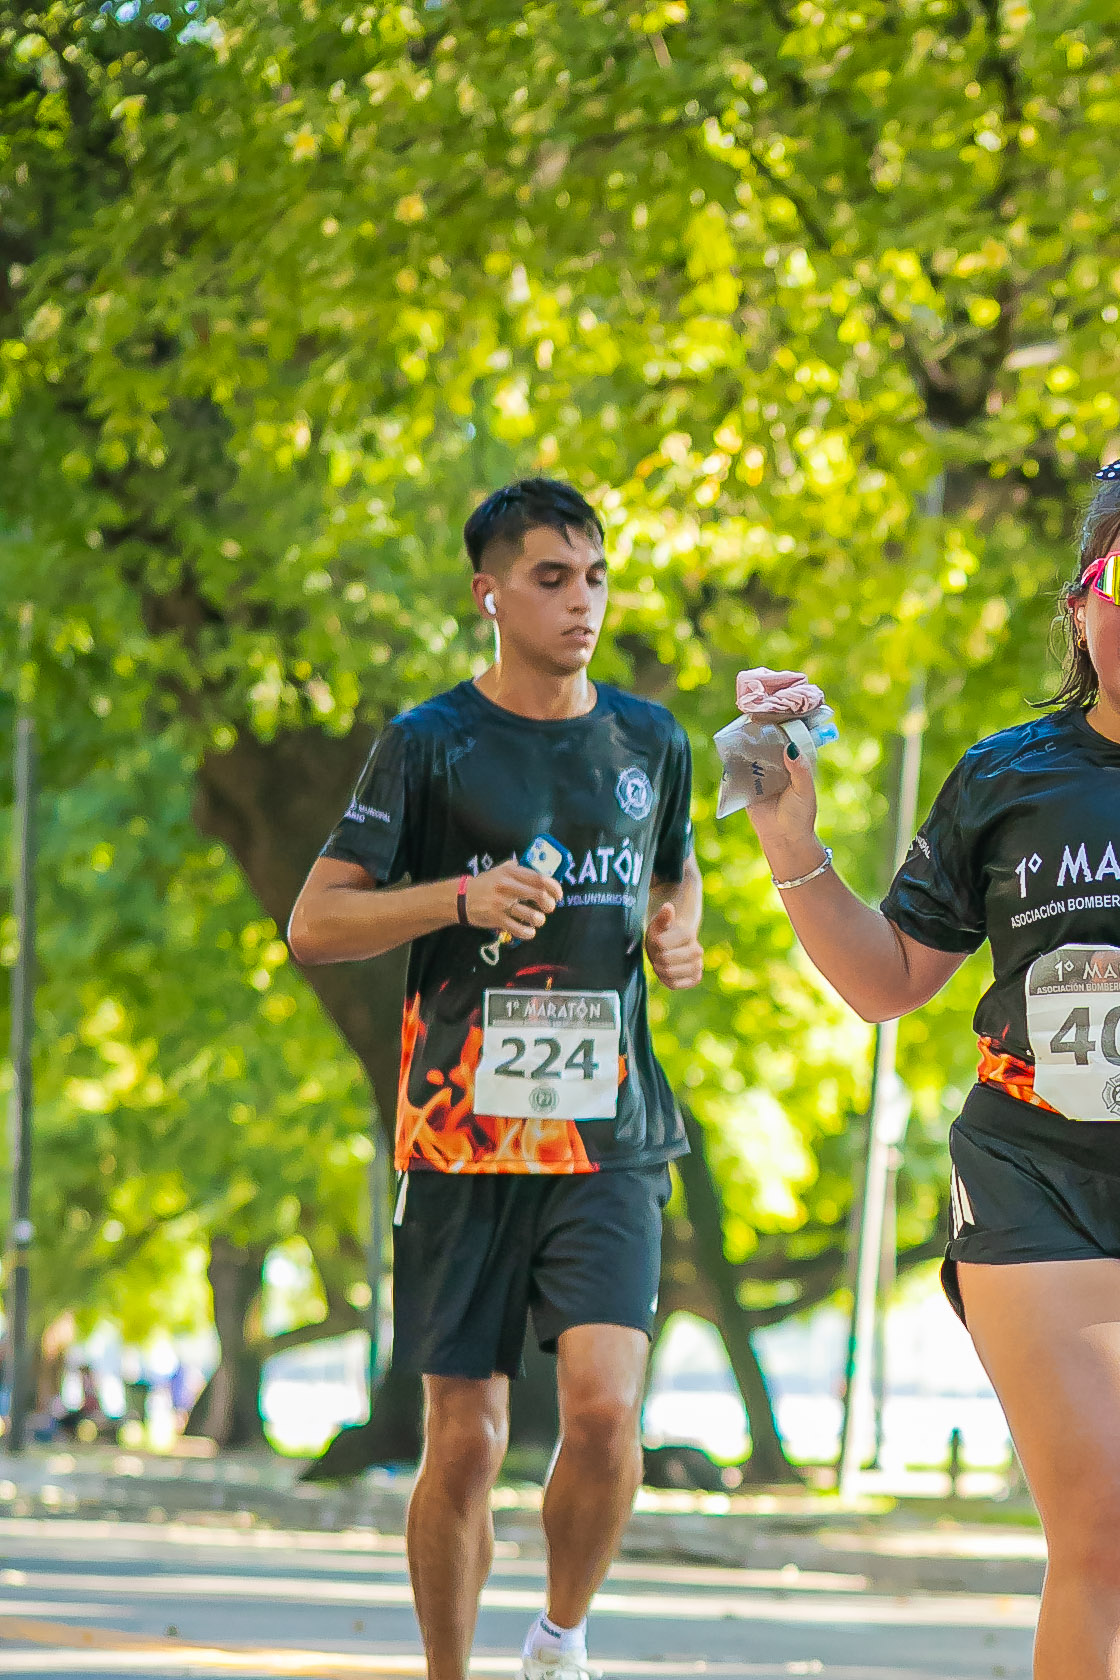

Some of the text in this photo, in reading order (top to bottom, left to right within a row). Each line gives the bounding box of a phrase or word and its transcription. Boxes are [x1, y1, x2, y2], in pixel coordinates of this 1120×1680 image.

[1010, 900, 1066, 929] ASOCIACIÓN
[1036, 982, 1085, 995] ASOCIACIÓN
[523, 997, 601, 1019] MARATÓN
[494, 1036, 599, 1081] 224
